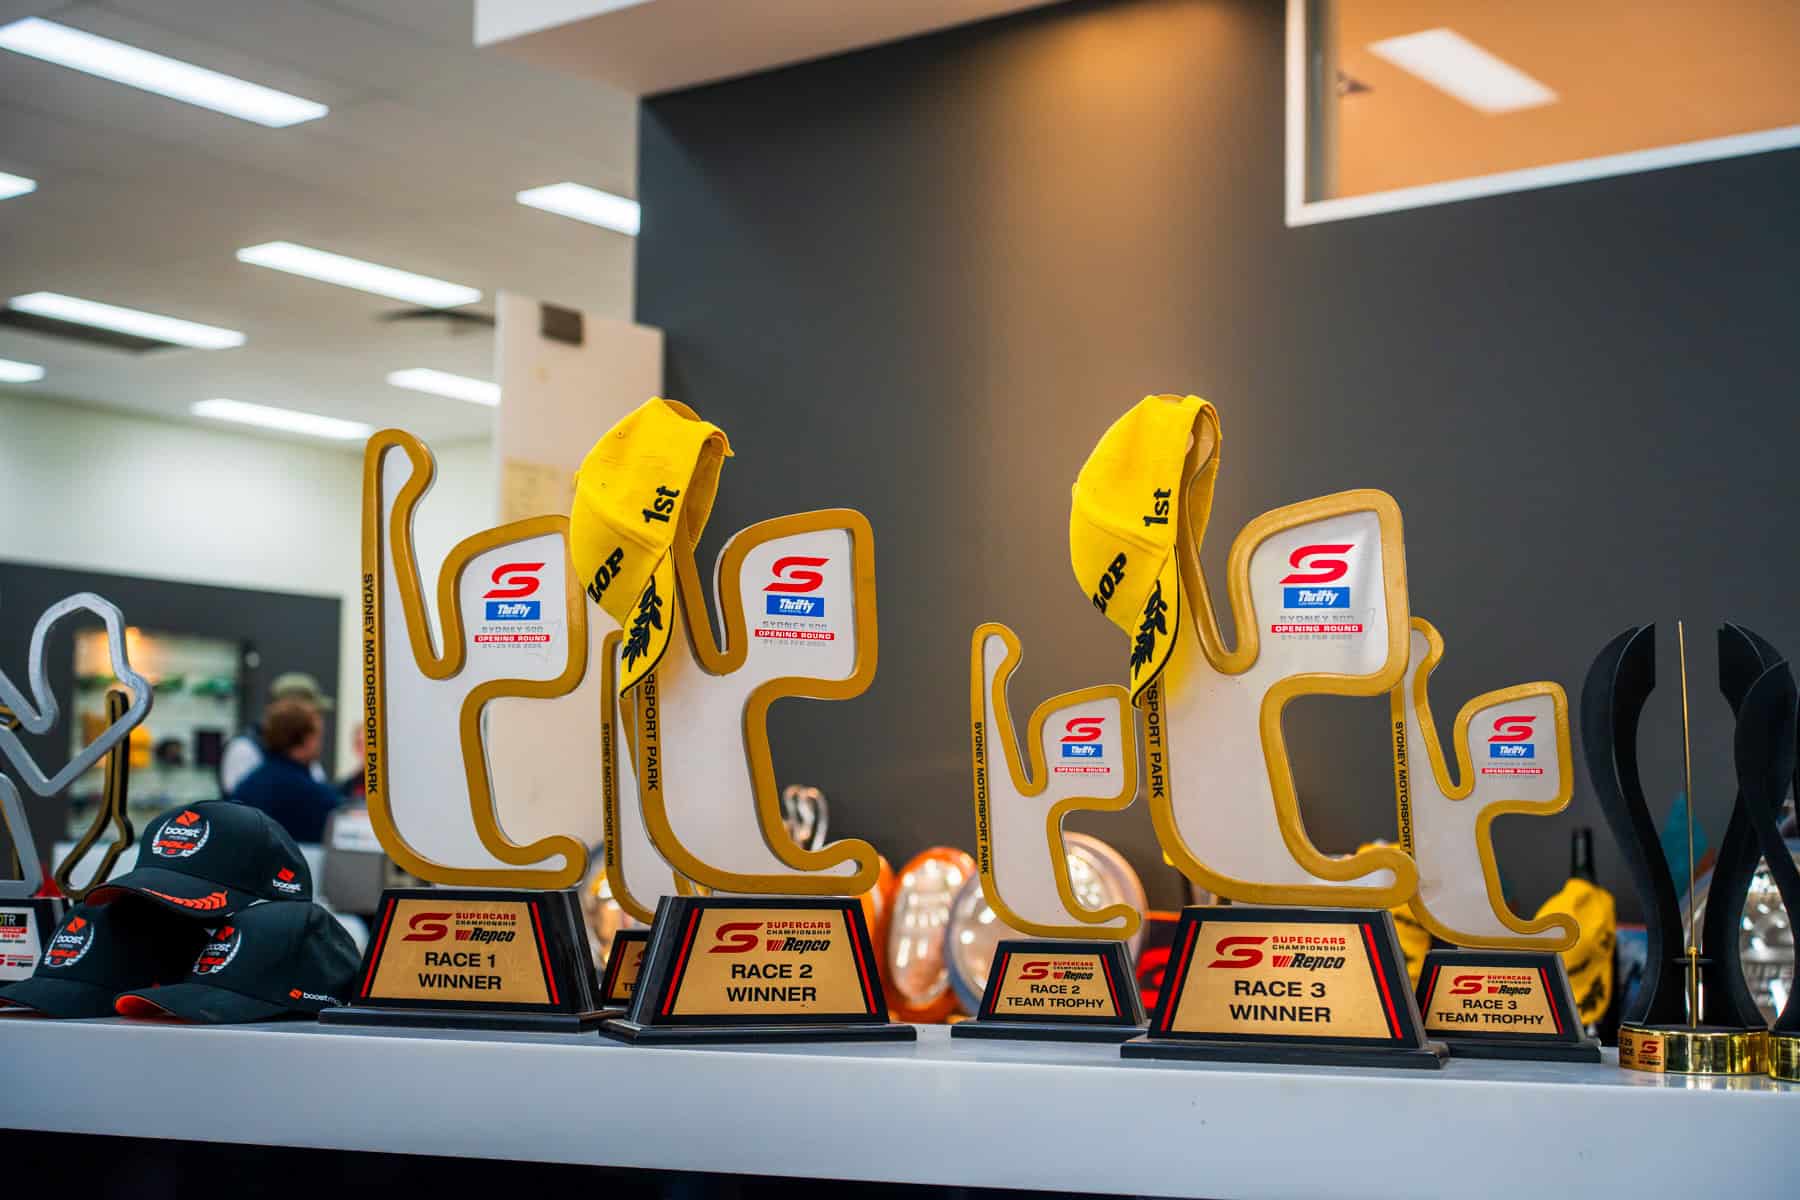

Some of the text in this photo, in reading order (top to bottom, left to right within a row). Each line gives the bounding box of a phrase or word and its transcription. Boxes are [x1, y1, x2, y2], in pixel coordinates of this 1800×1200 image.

[641, 486, 680, 523] 1st
[1142, 488, 1171, 527] 1st
[779, 598, 815, 614] Thrifty
[1298, 590, 1339, 606] Thrifty
[497, 603, 532, 617] Thrifty
[758, 630, 798, 638] OPENING
[364, 573, 378, 794] SYDNEY MOTORSPORT PARK
[1395, 721, 1406, 767] SYDNEY
[647, 746, 658, 790] PARK
[1150, 752, 1165, 798] PARK
[974, 722, 989, 874] SYDNEY MOTORSPORT PARK
[1399, 769, 1411, 849] MOTORSPORT
[455, 912, 517, 921] SUPERCARS
[767, 921, 831, 929] SUPERCARS
[469, 927, 516, 944] Repco
[1272, 936, 1346, 945] SUPERCARS
[782, 937, 831, 954] Repco
[425, 952, 496, 968] RACE 1
[1290, 953, 1346, 971] Repco
[731, 964, 813, 979] RACE 2
[1063, 971, 1094, 981] Repco
[418, 973, 502, 990] WINNER
[1031, 984, 1080, 994] RACE 2
[1234, 980, 1326, 998] RACE 3
[726, 987, 816, 1002] WINNER
[1497, 985, 1532, 995] Repco
[1006, 997, 1104, 1008] TEAM TROPHY
[1462, 999, 1517, 1010] RACE 3
[1229, 1004, 1331, 1022] WINNER
[1436, 1012, 1544, 1024] TEAM TROPHY
